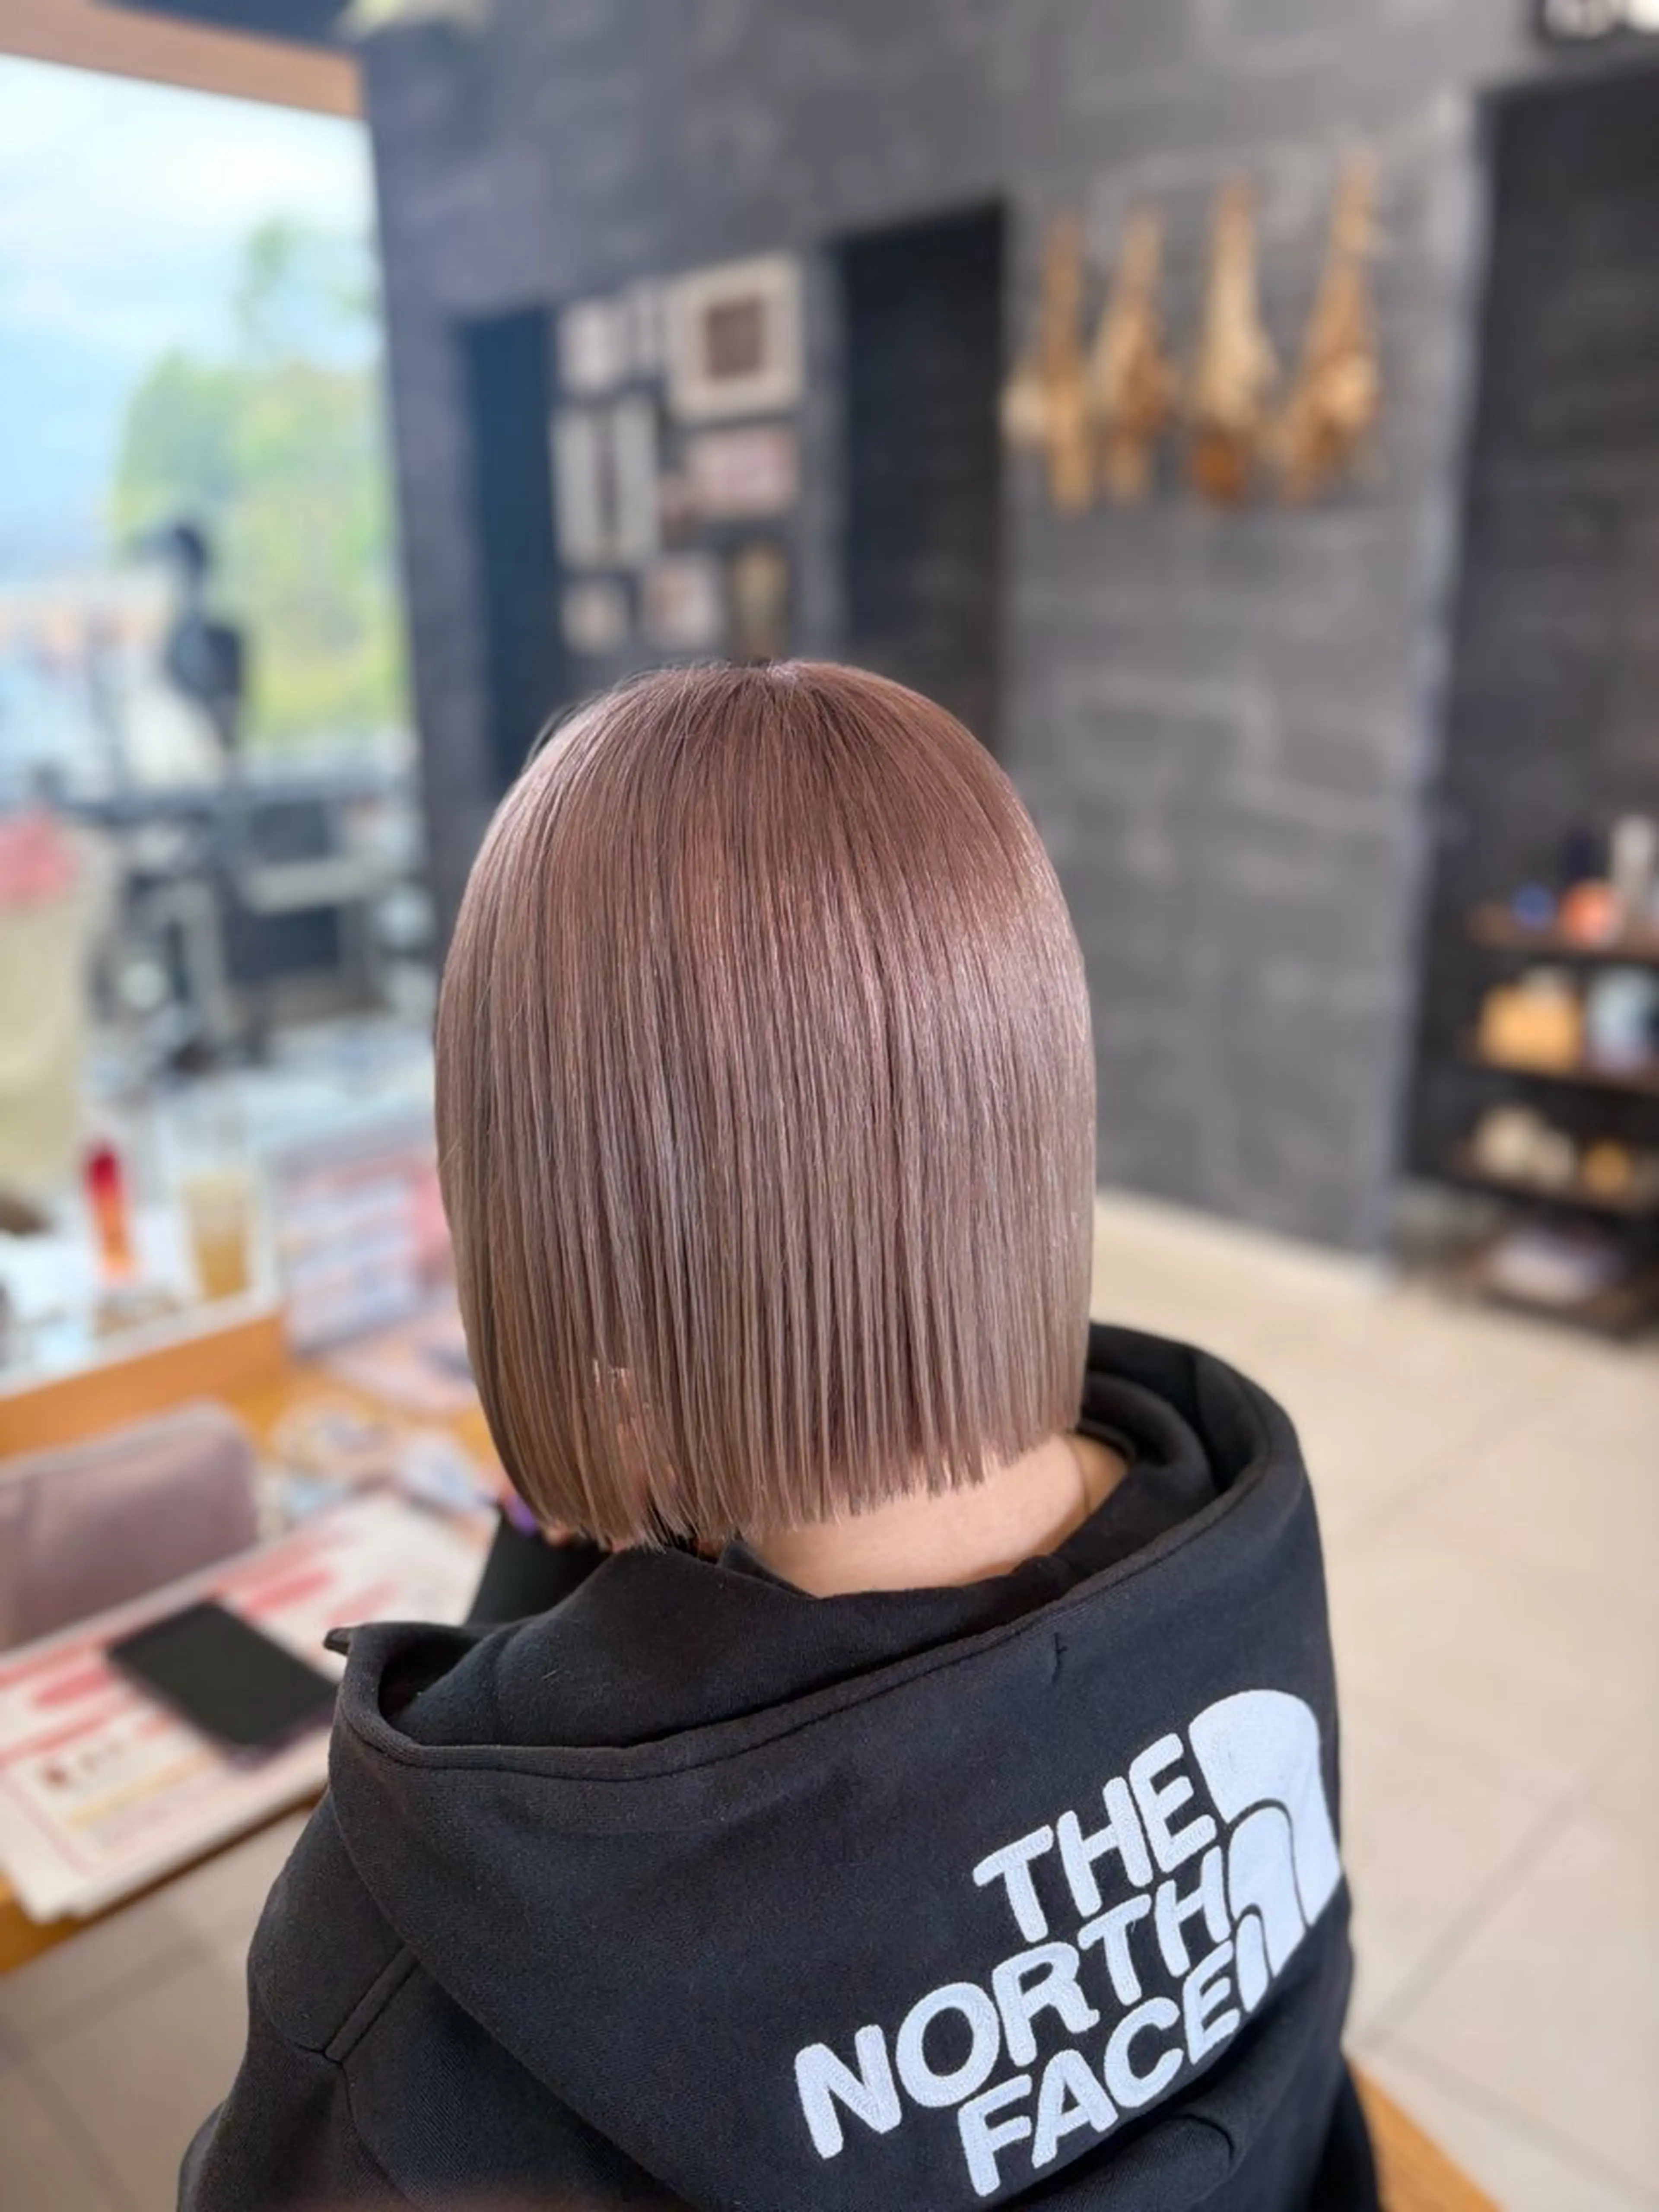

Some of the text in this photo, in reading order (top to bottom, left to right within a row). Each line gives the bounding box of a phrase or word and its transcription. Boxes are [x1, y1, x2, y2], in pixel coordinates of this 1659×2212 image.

[973, 1733, 1217, 1943] THE
[794, 1845, 1232, 2159] NORTH
[958, 1939, 1241, 2196] FACE
